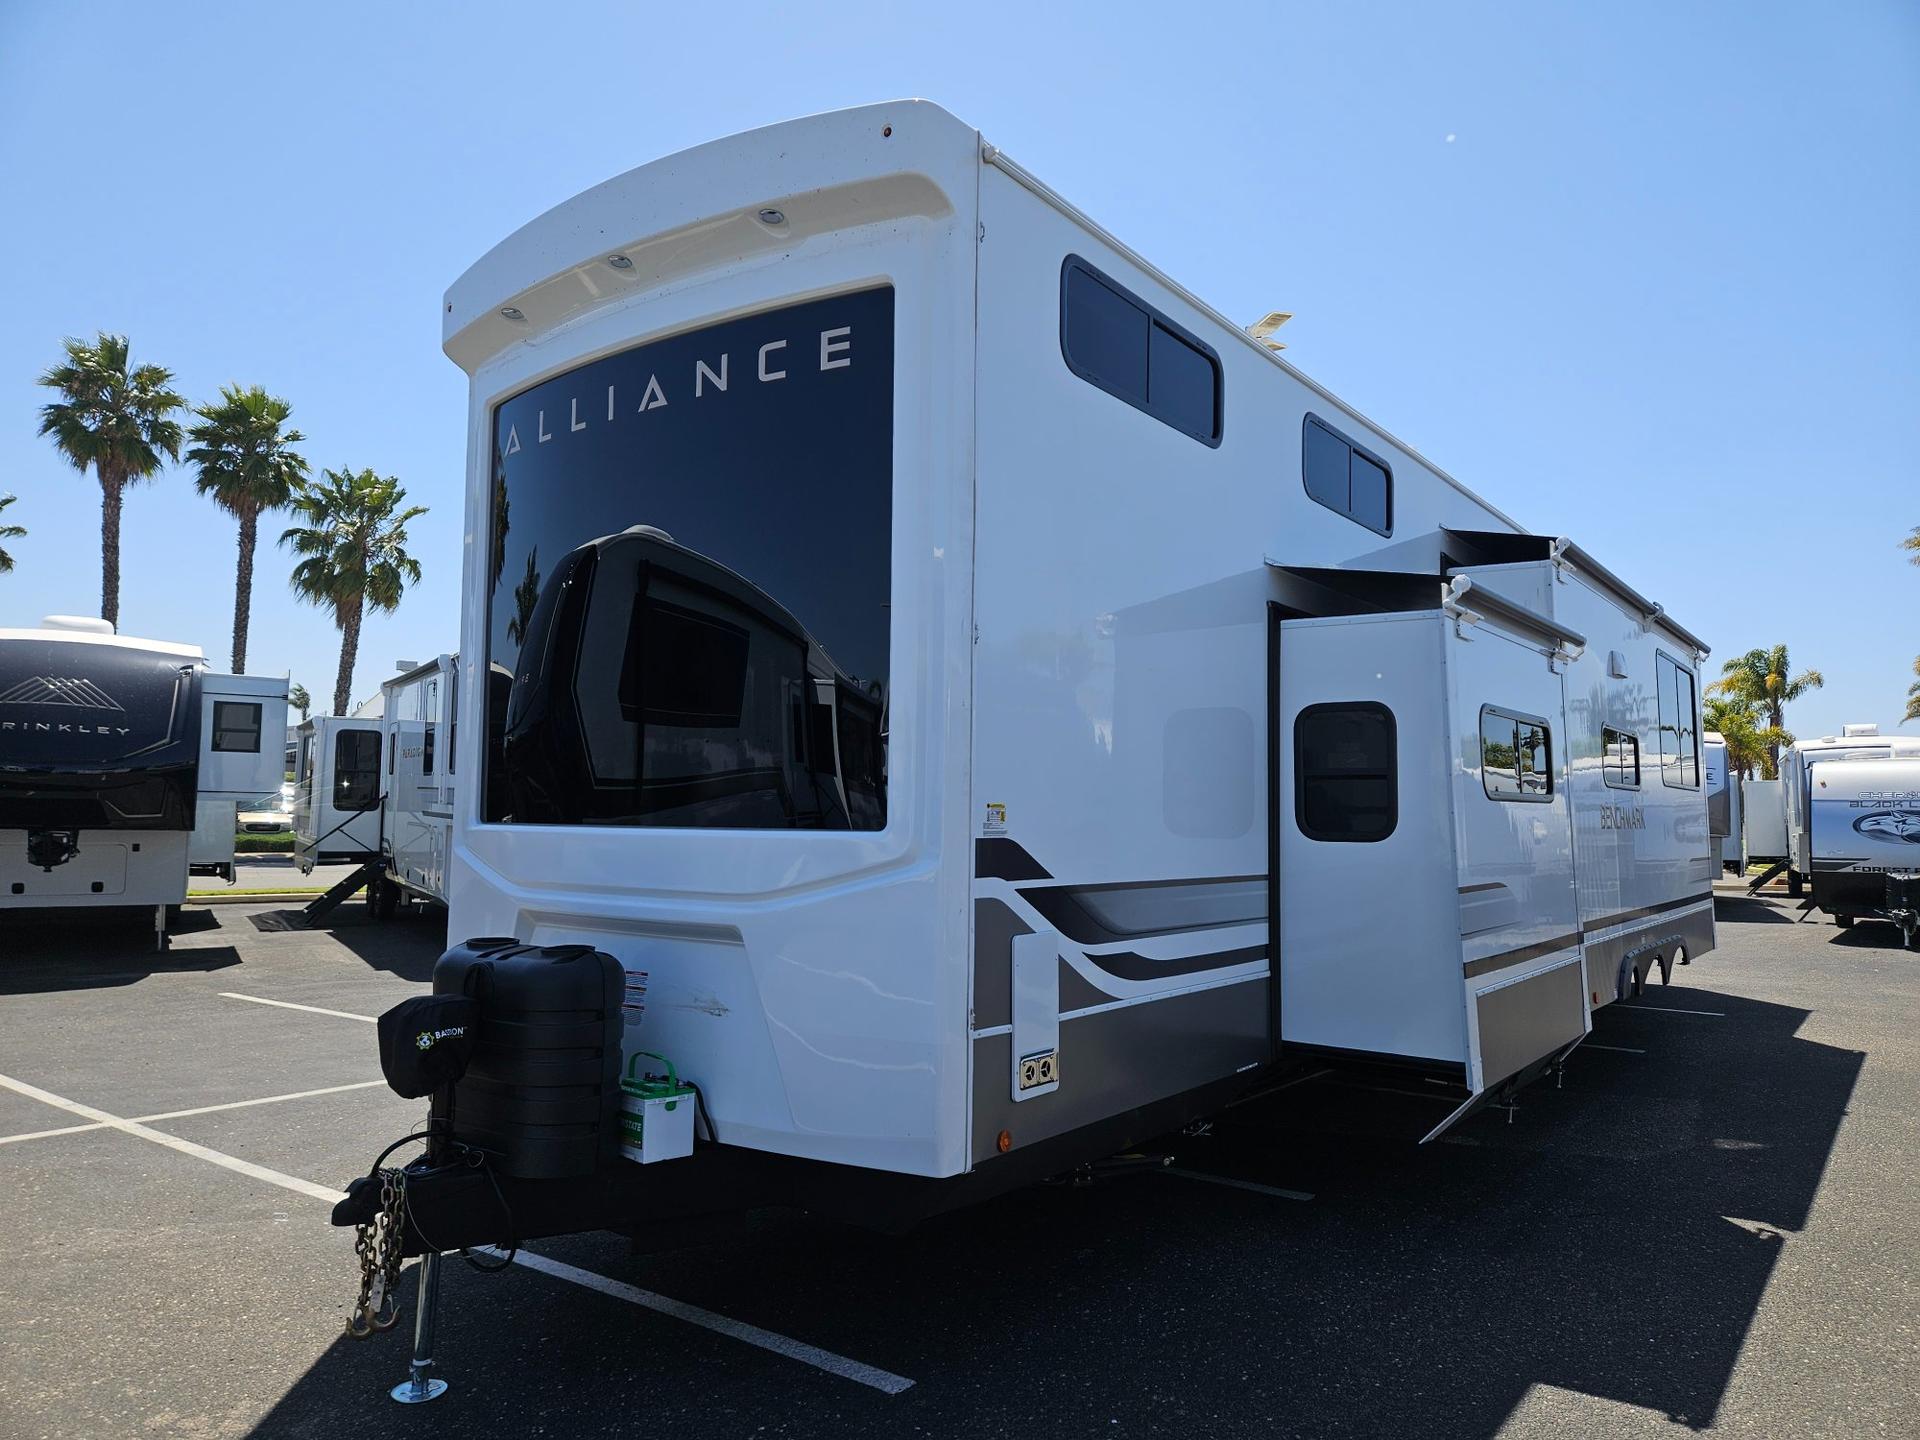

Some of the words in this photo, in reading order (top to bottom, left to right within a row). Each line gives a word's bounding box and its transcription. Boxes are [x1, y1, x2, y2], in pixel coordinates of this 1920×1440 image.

[504, 326, 852, 458] ALLIANCE
[2, 722, 130, 736] RINKLEY
[1859, 791, 1920, 799] CHER
